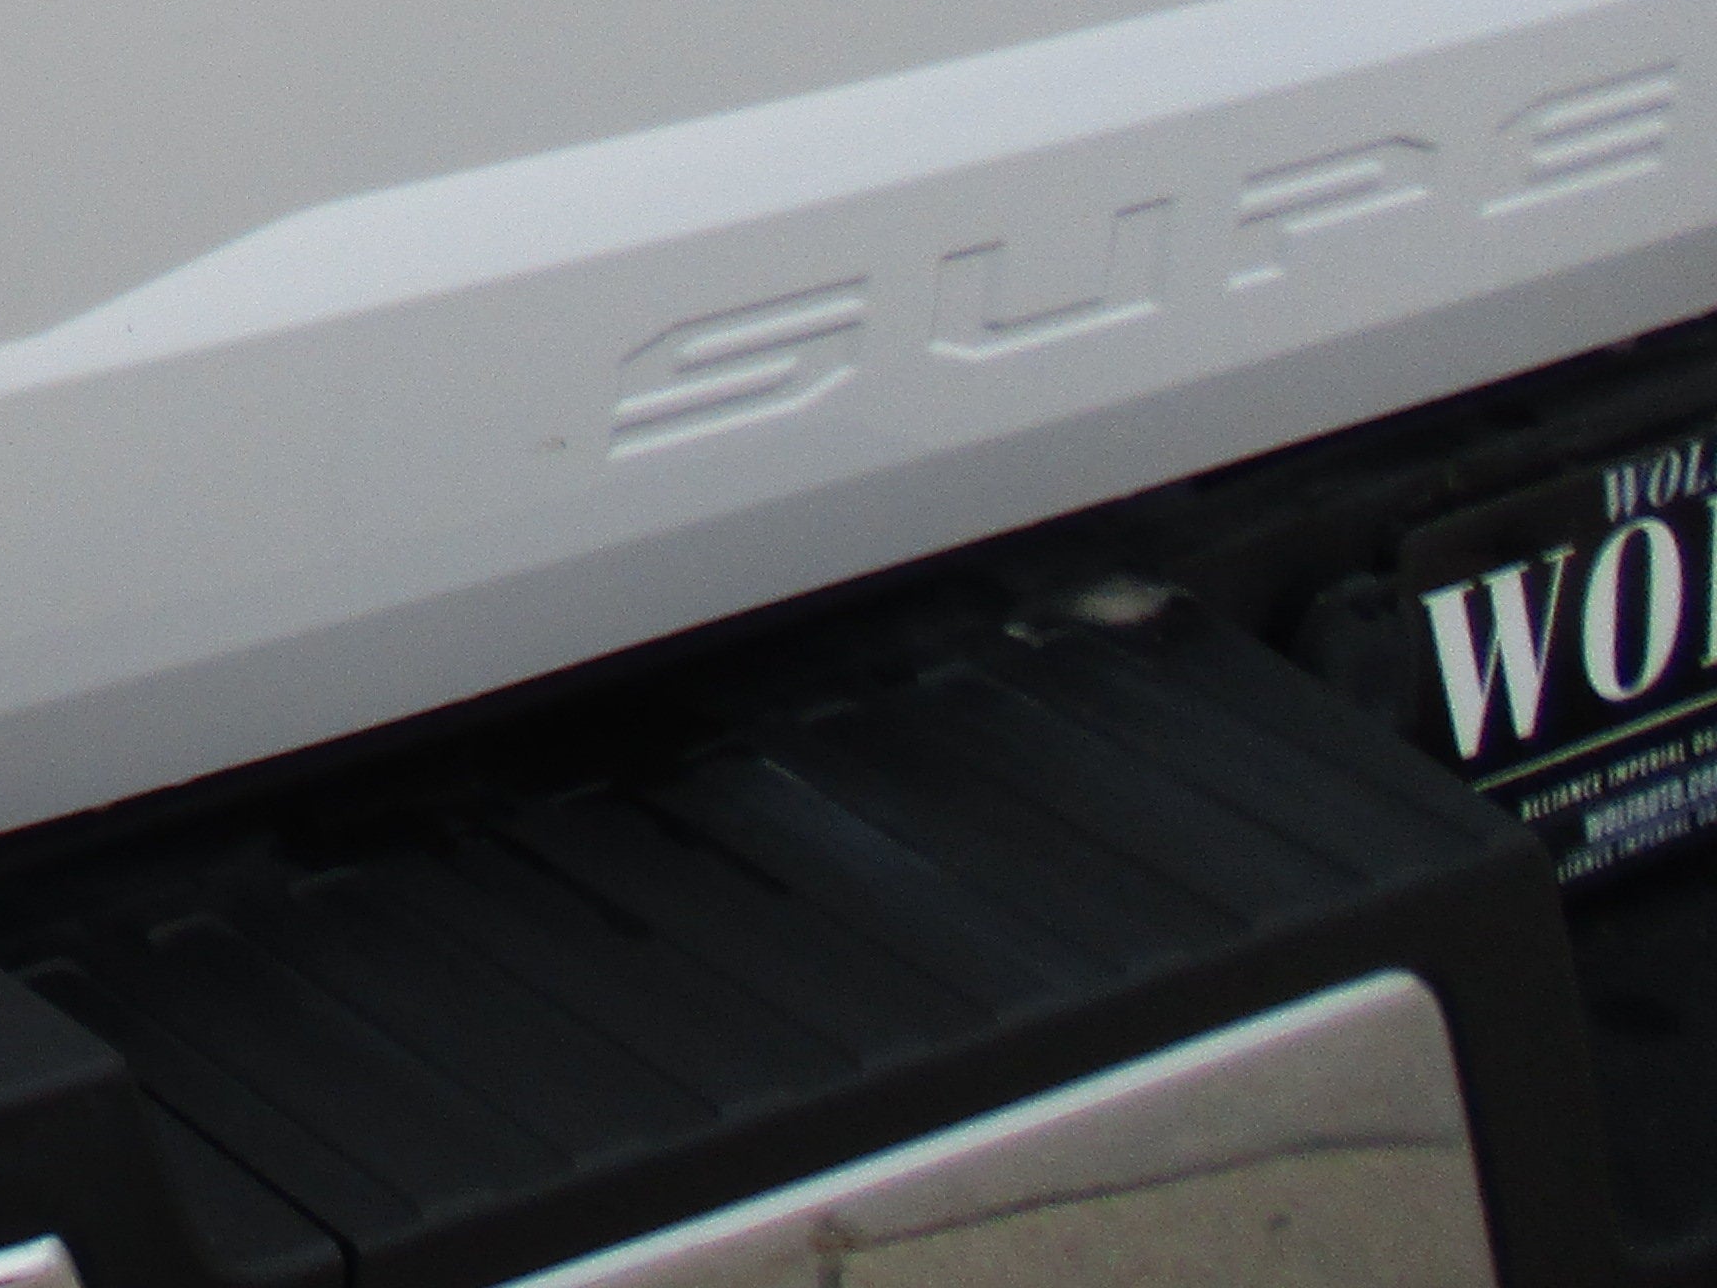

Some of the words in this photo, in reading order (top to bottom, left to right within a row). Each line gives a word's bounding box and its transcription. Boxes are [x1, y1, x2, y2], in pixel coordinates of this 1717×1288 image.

[1417, 492, 1717, 760] WO
[1585, 761, 1717, 843] WOLFAUTO.CO
[1607, 738, 1686, 787] IMPERIAL
